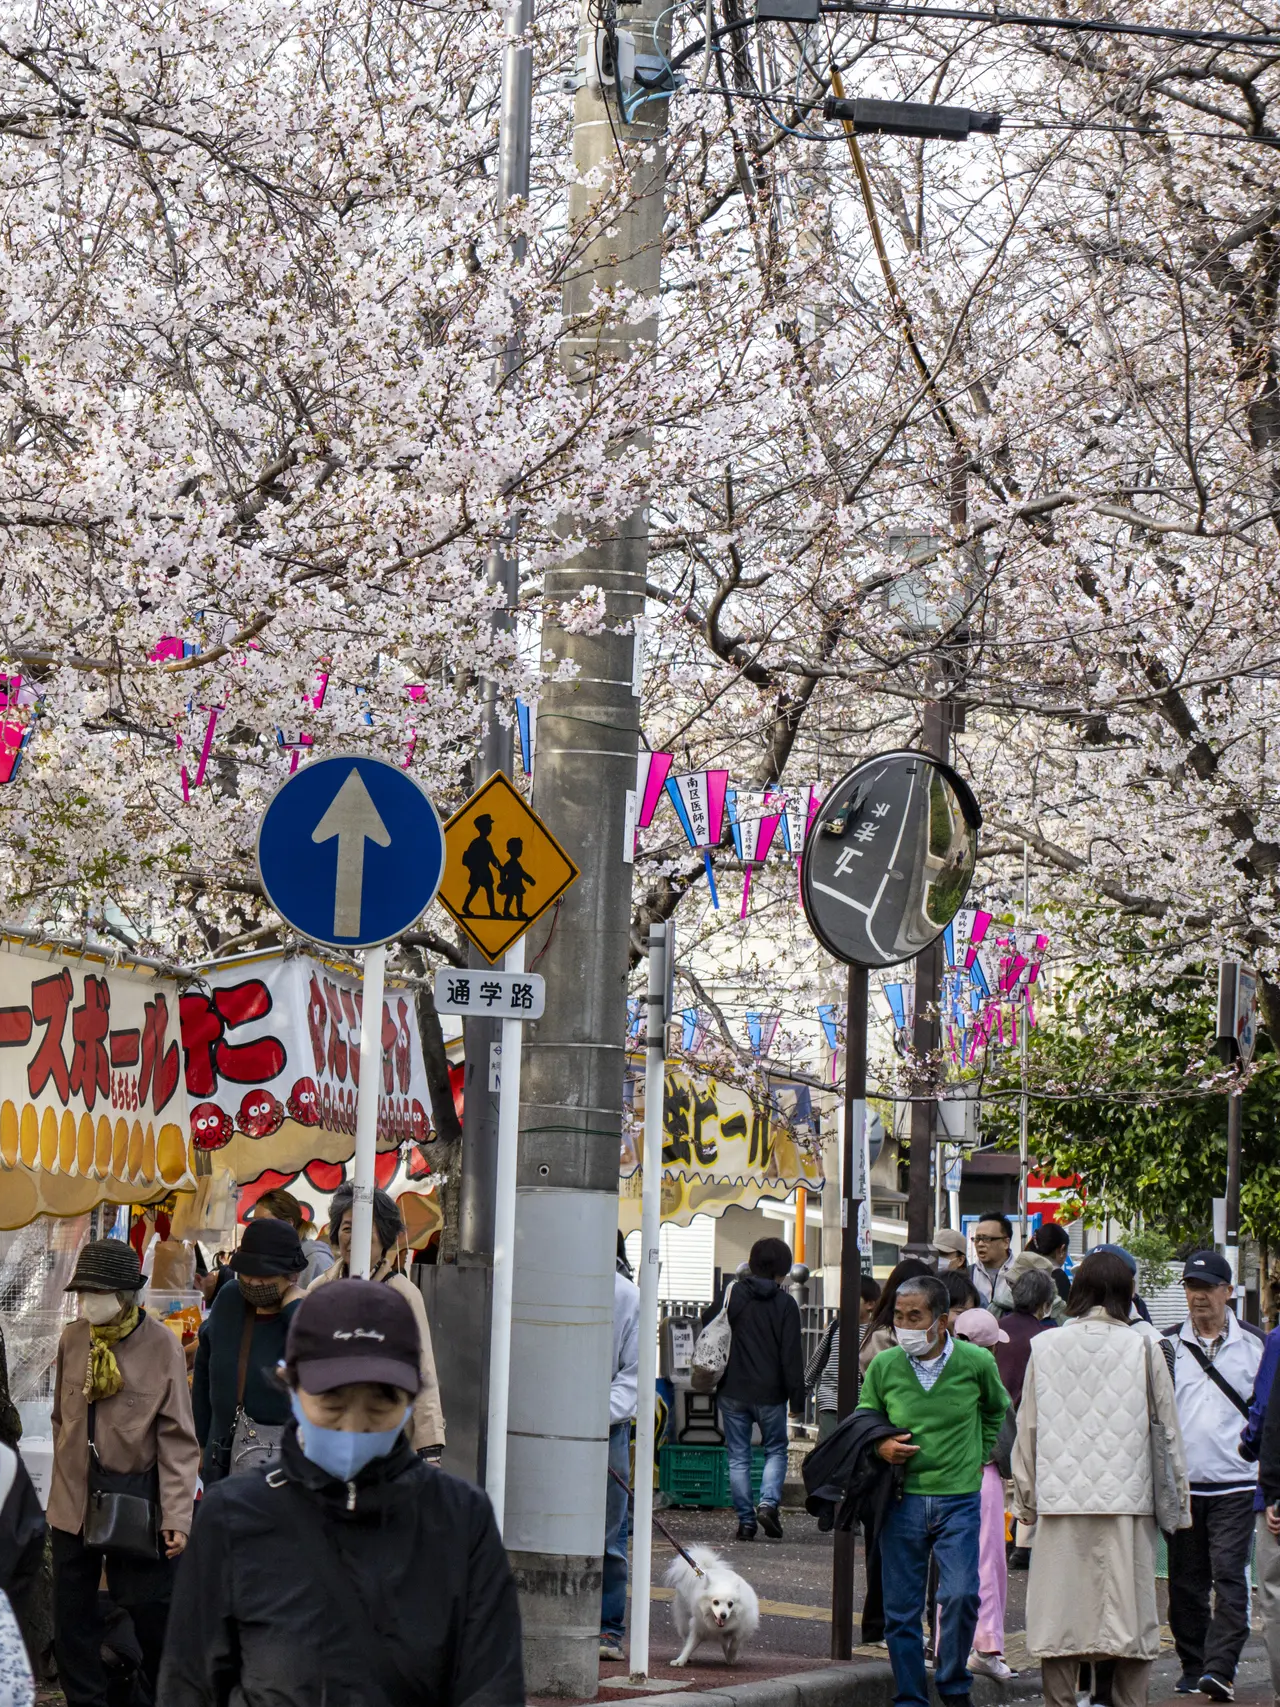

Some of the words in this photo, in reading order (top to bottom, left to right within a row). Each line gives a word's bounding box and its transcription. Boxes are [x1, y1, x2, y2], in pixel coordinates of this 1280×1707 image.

[686, 777, 706, 836] 南区医師会
[446, 978, 534, 1009] 通学路
